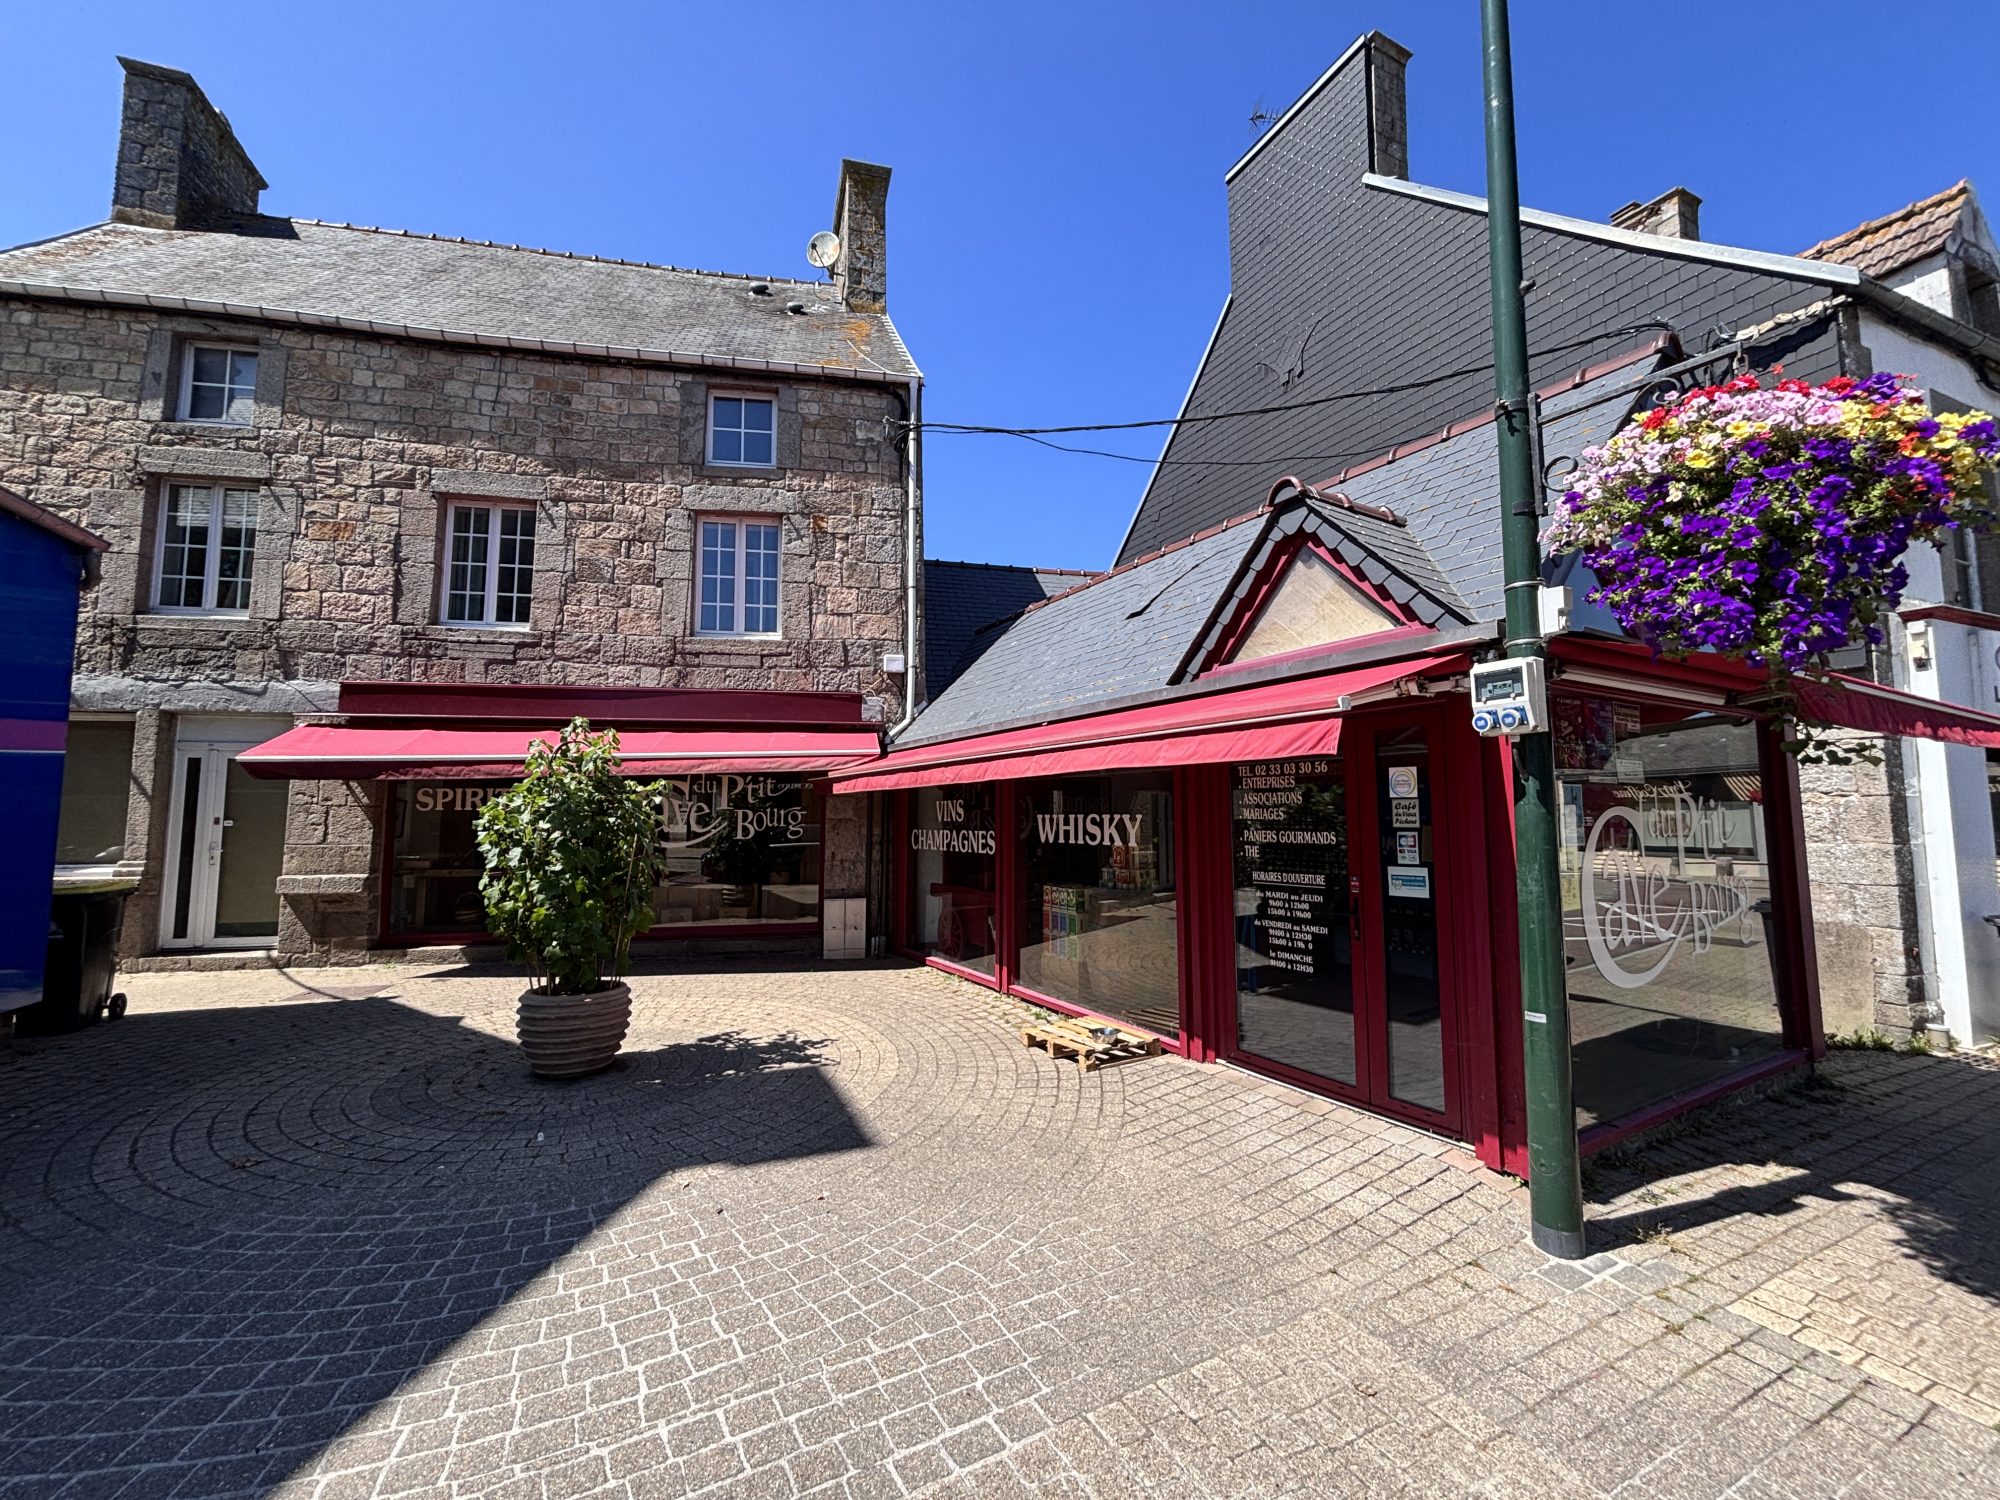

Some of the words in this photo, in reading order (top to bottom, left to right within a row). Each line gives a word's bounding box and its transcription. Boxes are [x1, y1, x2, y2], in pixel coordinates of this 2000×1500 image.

[1238, 766, 1253, 777] TEL.
[1255, 764, 1266, 776] 02
[1269, 763, 1281, 775] 33
[1283, 762, 1296, 774] 03
[1299, 762, 1311, 774] 30
[1314, 761, 1328, 773] 56
[1242, 776, 1295, 789] ENTREPRISES
[691, 773, 716, 793] du
[715, 774, 789, 810] P'tit
[1243, 791, 1303, 805] ASSOCIATIONS
[935, 800, 964, 823] VINS
[1243, 807, 1284, 820] MARIAGES
[731, 806, 807, 840] Bourg
[1037, 813, 1143, 847] WHISKY
[911, 829, 996, 855] CHAMPAGNES
[1244, 830, 1277, 843] PANIERS
[1279, 830, 1337, 845] GOURMANDS
[1244, 845, 1260, 857] THE
[1252, 871, 1282, 883] HORAIRES
[1282, 872, 1326, 886] D'OUVERTURE
[1256, 889, 1264, 897] du
[1265, 891, 1289, 900] MARDI
[1300, 894, 1323, 903] JEUDI
[1582, 800, 1690, 988] Cave
[1686, 871, 1752, 956] Bourg
[1254, 918, 1261, 926] du
[1261, 919, 1292, 930] VENDREDI
[1301, 924, 1328, 935] SAMEDI
[1291, 932, 1312, 941] 12H30
[1277, 951, 1313, 964] DIMANCHE
[1293, 963, 1314, 974] 12H30
